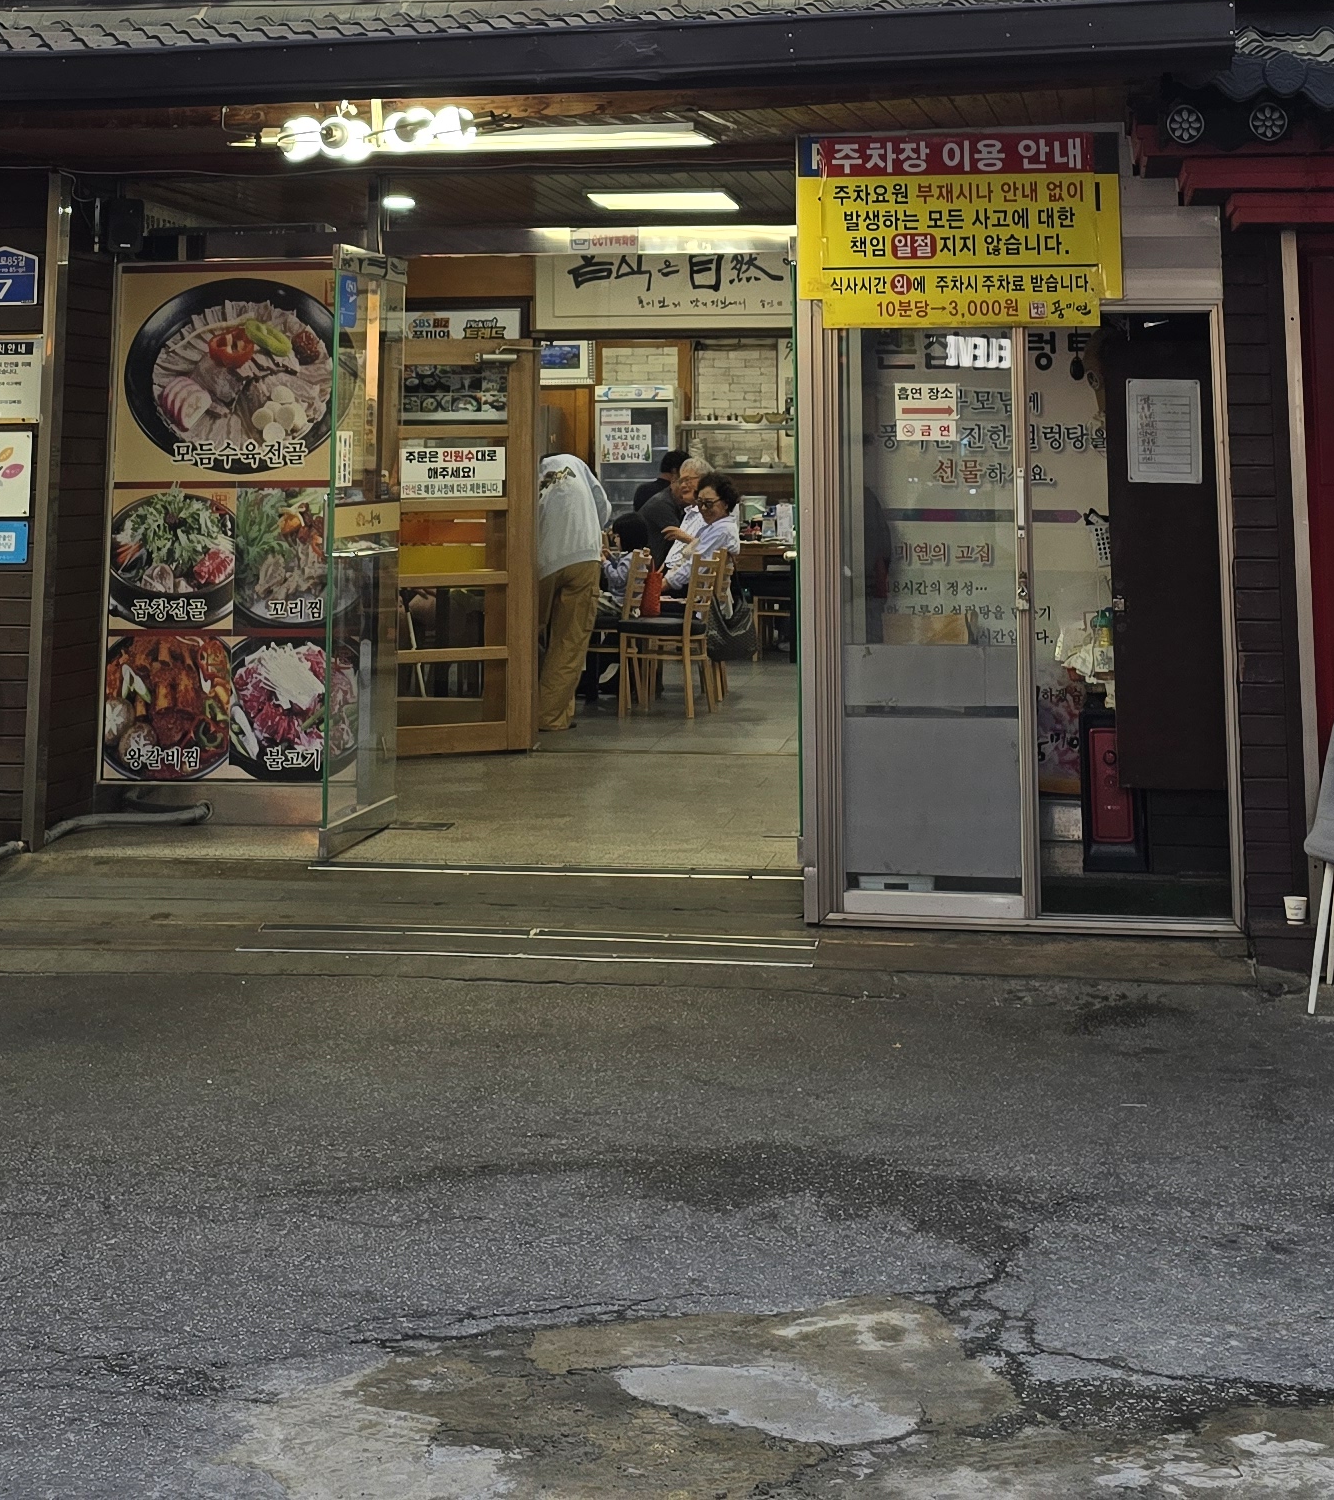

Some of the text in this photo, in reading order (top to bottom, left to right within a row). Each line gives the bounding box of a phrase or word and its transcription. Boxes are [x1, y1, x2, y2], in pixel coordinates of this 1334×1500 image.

[831, 137, 1083, 174] 주차장 이용 안내
[833, 180, 1085, 206] 주차요원 부재시나 안내 없이
[843, 206, 1076, 231] 발생하는 모든 사고에 대한
[850, 233, 1070, 257] 책임 일절 지지 않습니다.
[830, 275, 887, 295] 식사시간
[935, 274, 978, 293] 주차시
[981, 274, 1026, 293] 주차료
[1030, 273, 1095, 294] 받습니다.
[412, 318, 431, 329] SBS
[897, 386, 954, 401] 흡연 장소
[405, 449, 498, 464] 주문은 인원수대로
[955, 542, 992, 564] 고집
[131, 598, 208, 622] 곱창전골
[268, 597, 324, 621] 꼬리찜
[124, 746, 201, 770] 왕갈비찜
[263, 747, 322, 771] 불고기
